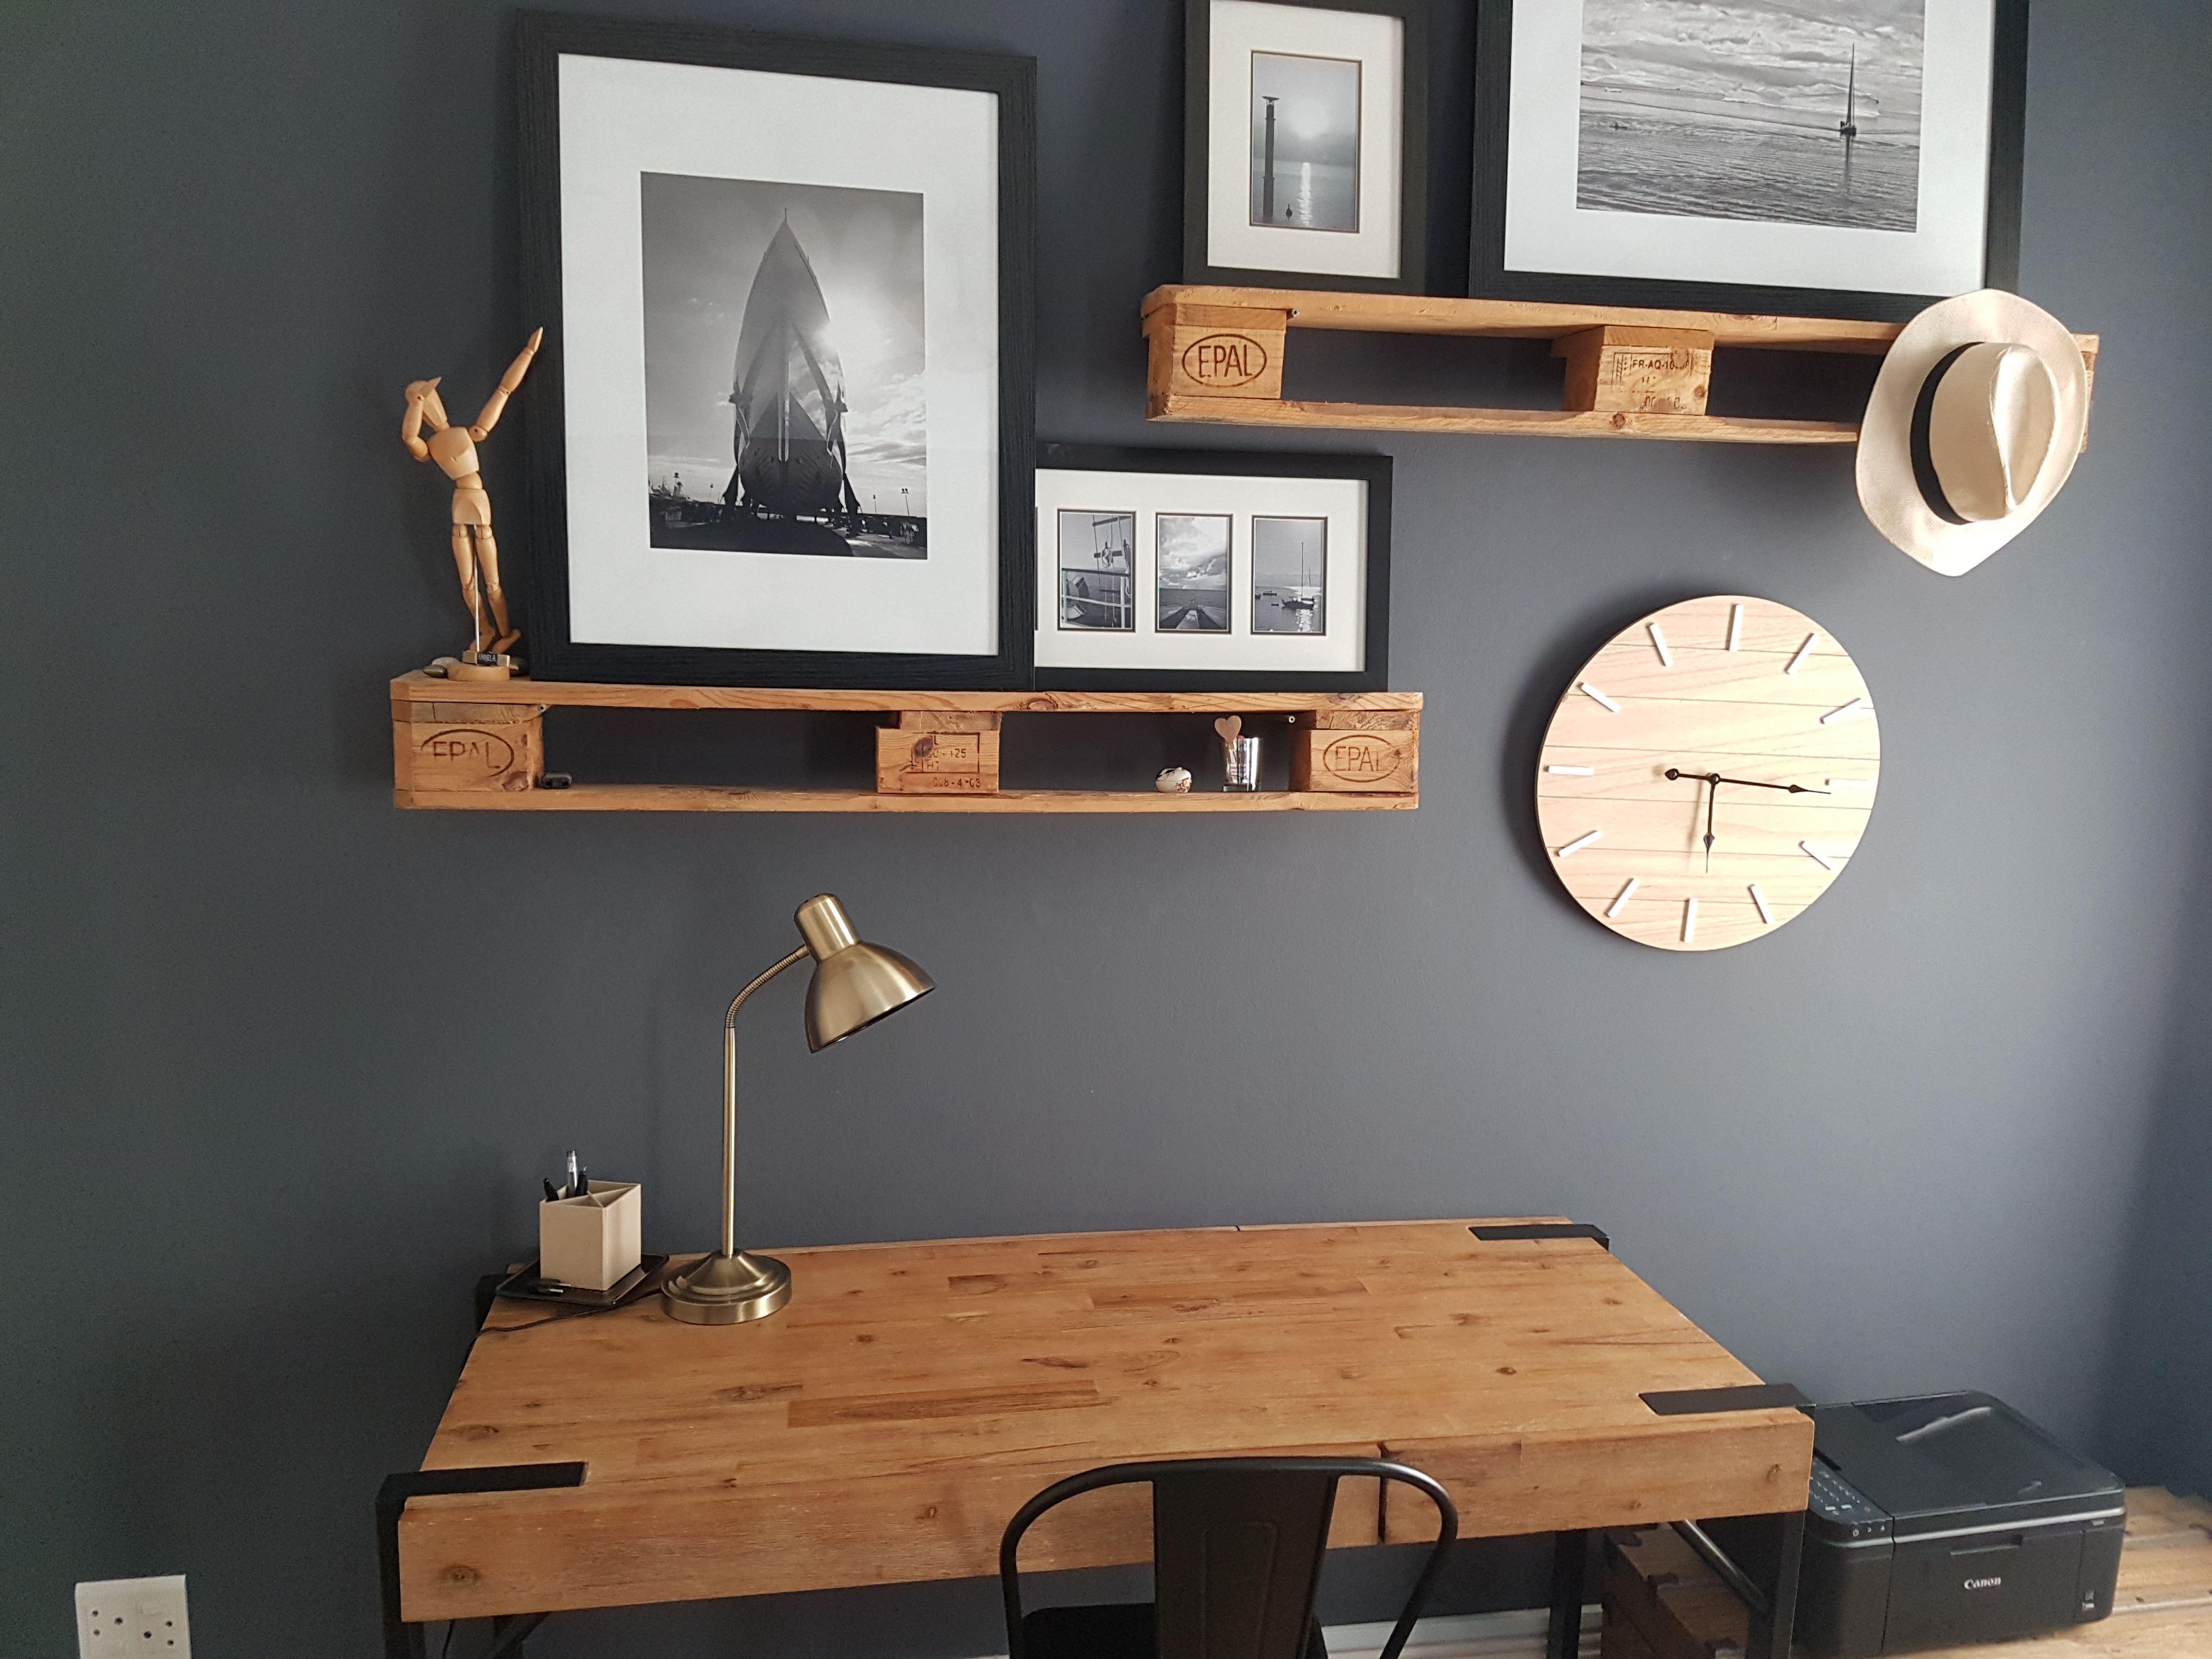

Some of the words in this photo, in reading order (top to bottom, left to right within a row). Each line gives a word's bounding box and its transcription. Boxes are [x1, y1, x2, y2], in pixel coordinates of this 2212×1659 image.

[1198, 344, 1253, 378] EPAL
[1335, 746, 1390, 772] EPAL
[1964, 1576, 2002, 1590] Canon
